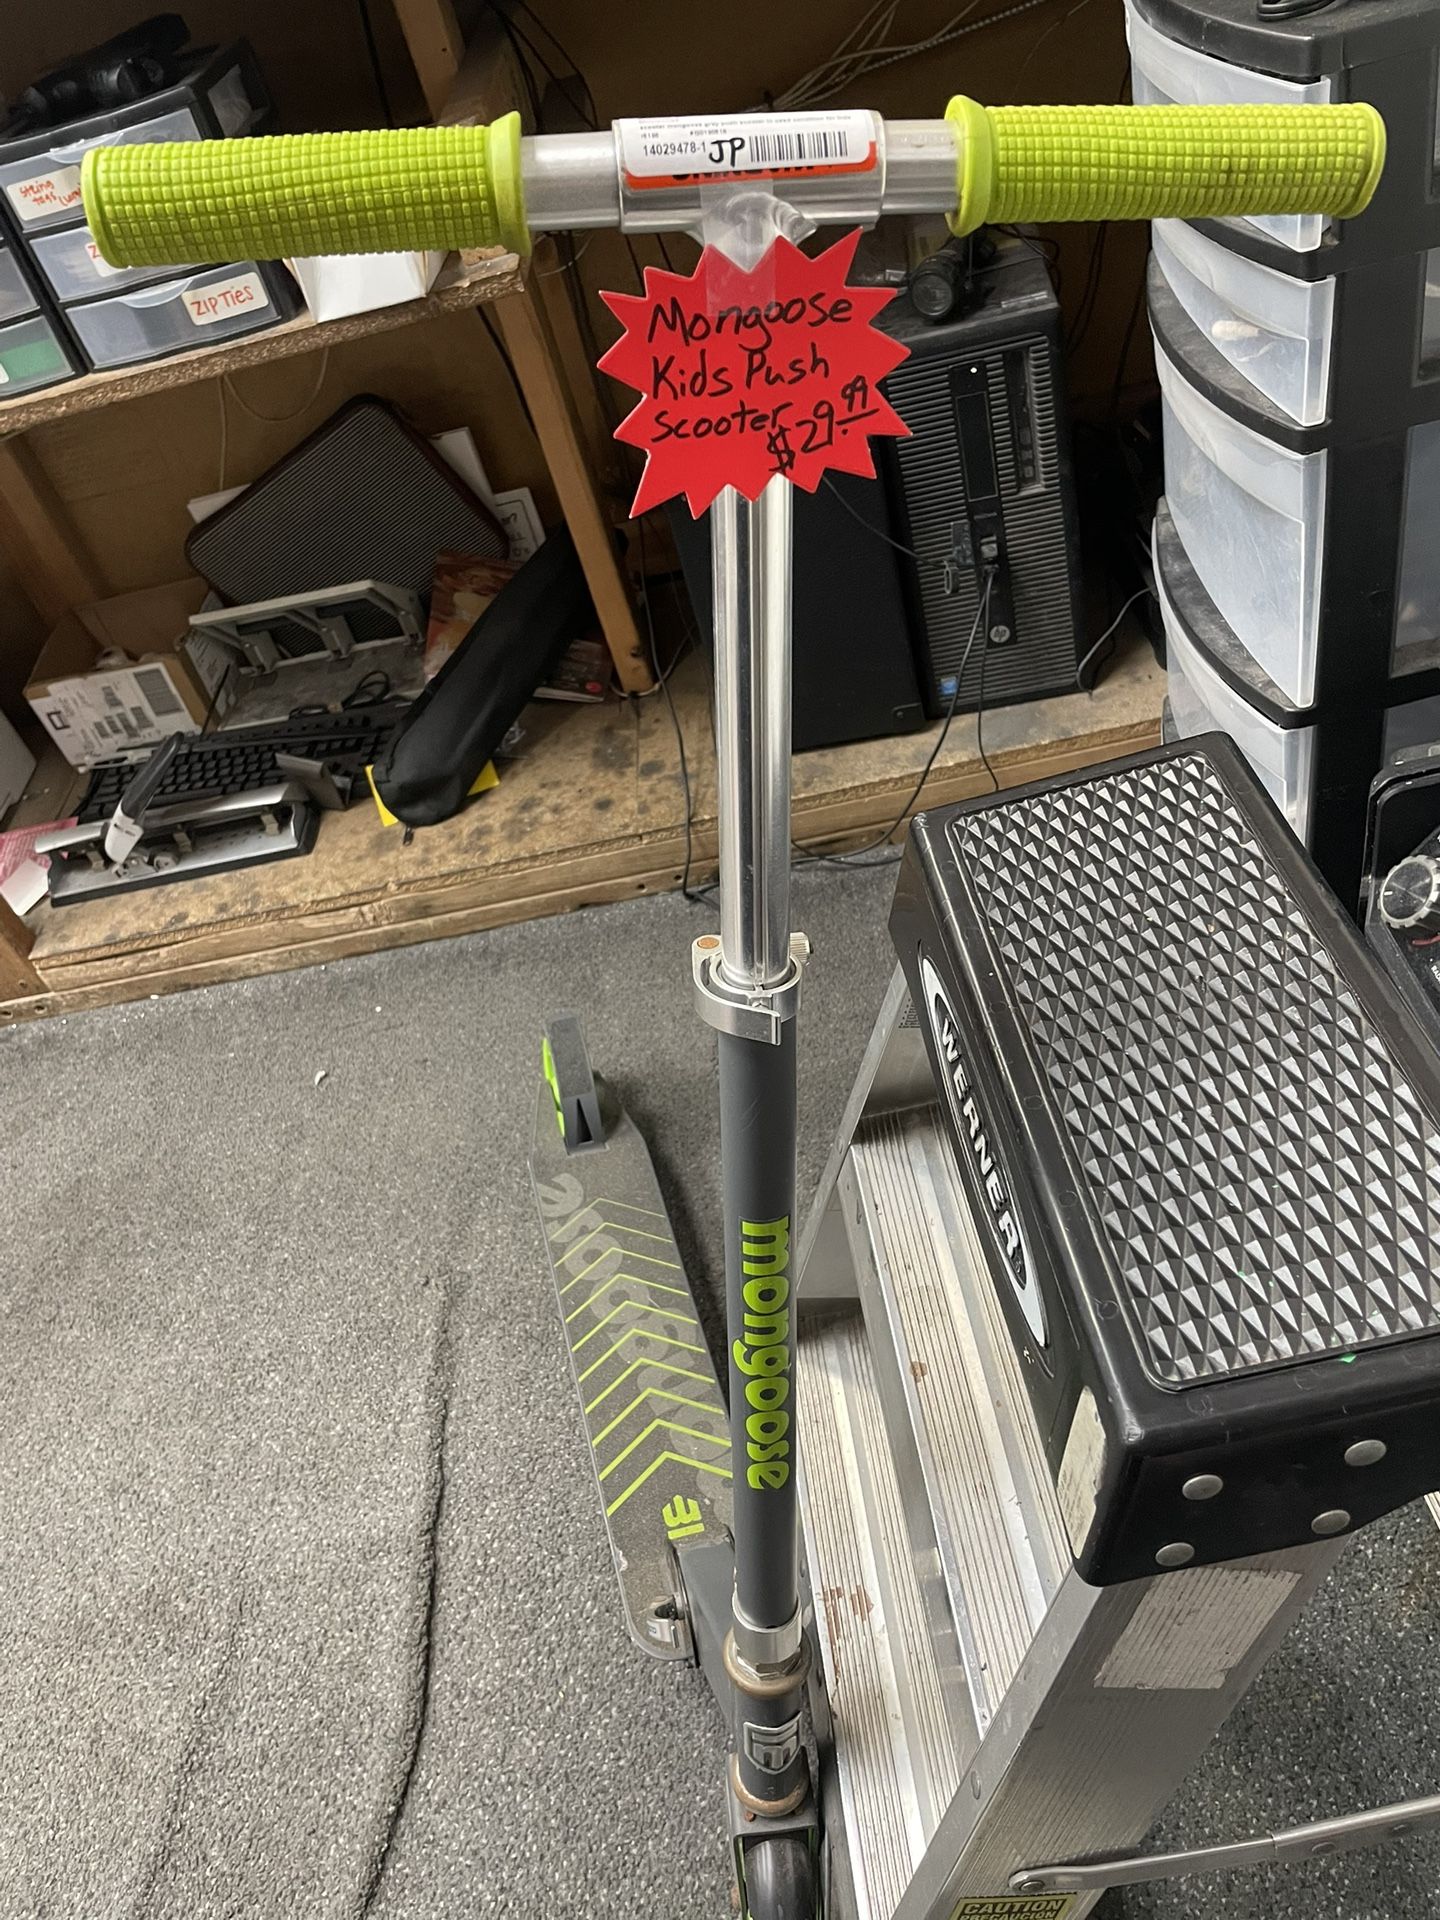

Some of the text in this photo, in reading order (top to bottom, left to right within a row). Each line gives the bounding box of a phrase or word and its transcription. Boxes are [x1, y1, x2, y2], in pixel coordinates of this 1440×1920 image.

[643, 141, 706, 157] 14029478-1
[708, 137, 746, 168] JP
[648, 292, 853, 351] Mongoose
[652, 342, 830, 401] Kids Push
[940, 1018, 1020, 1260] WERNER
[733, 1215, 790, 1490] mongoose
[963, 1900, 1064, 1914] CAUTION
